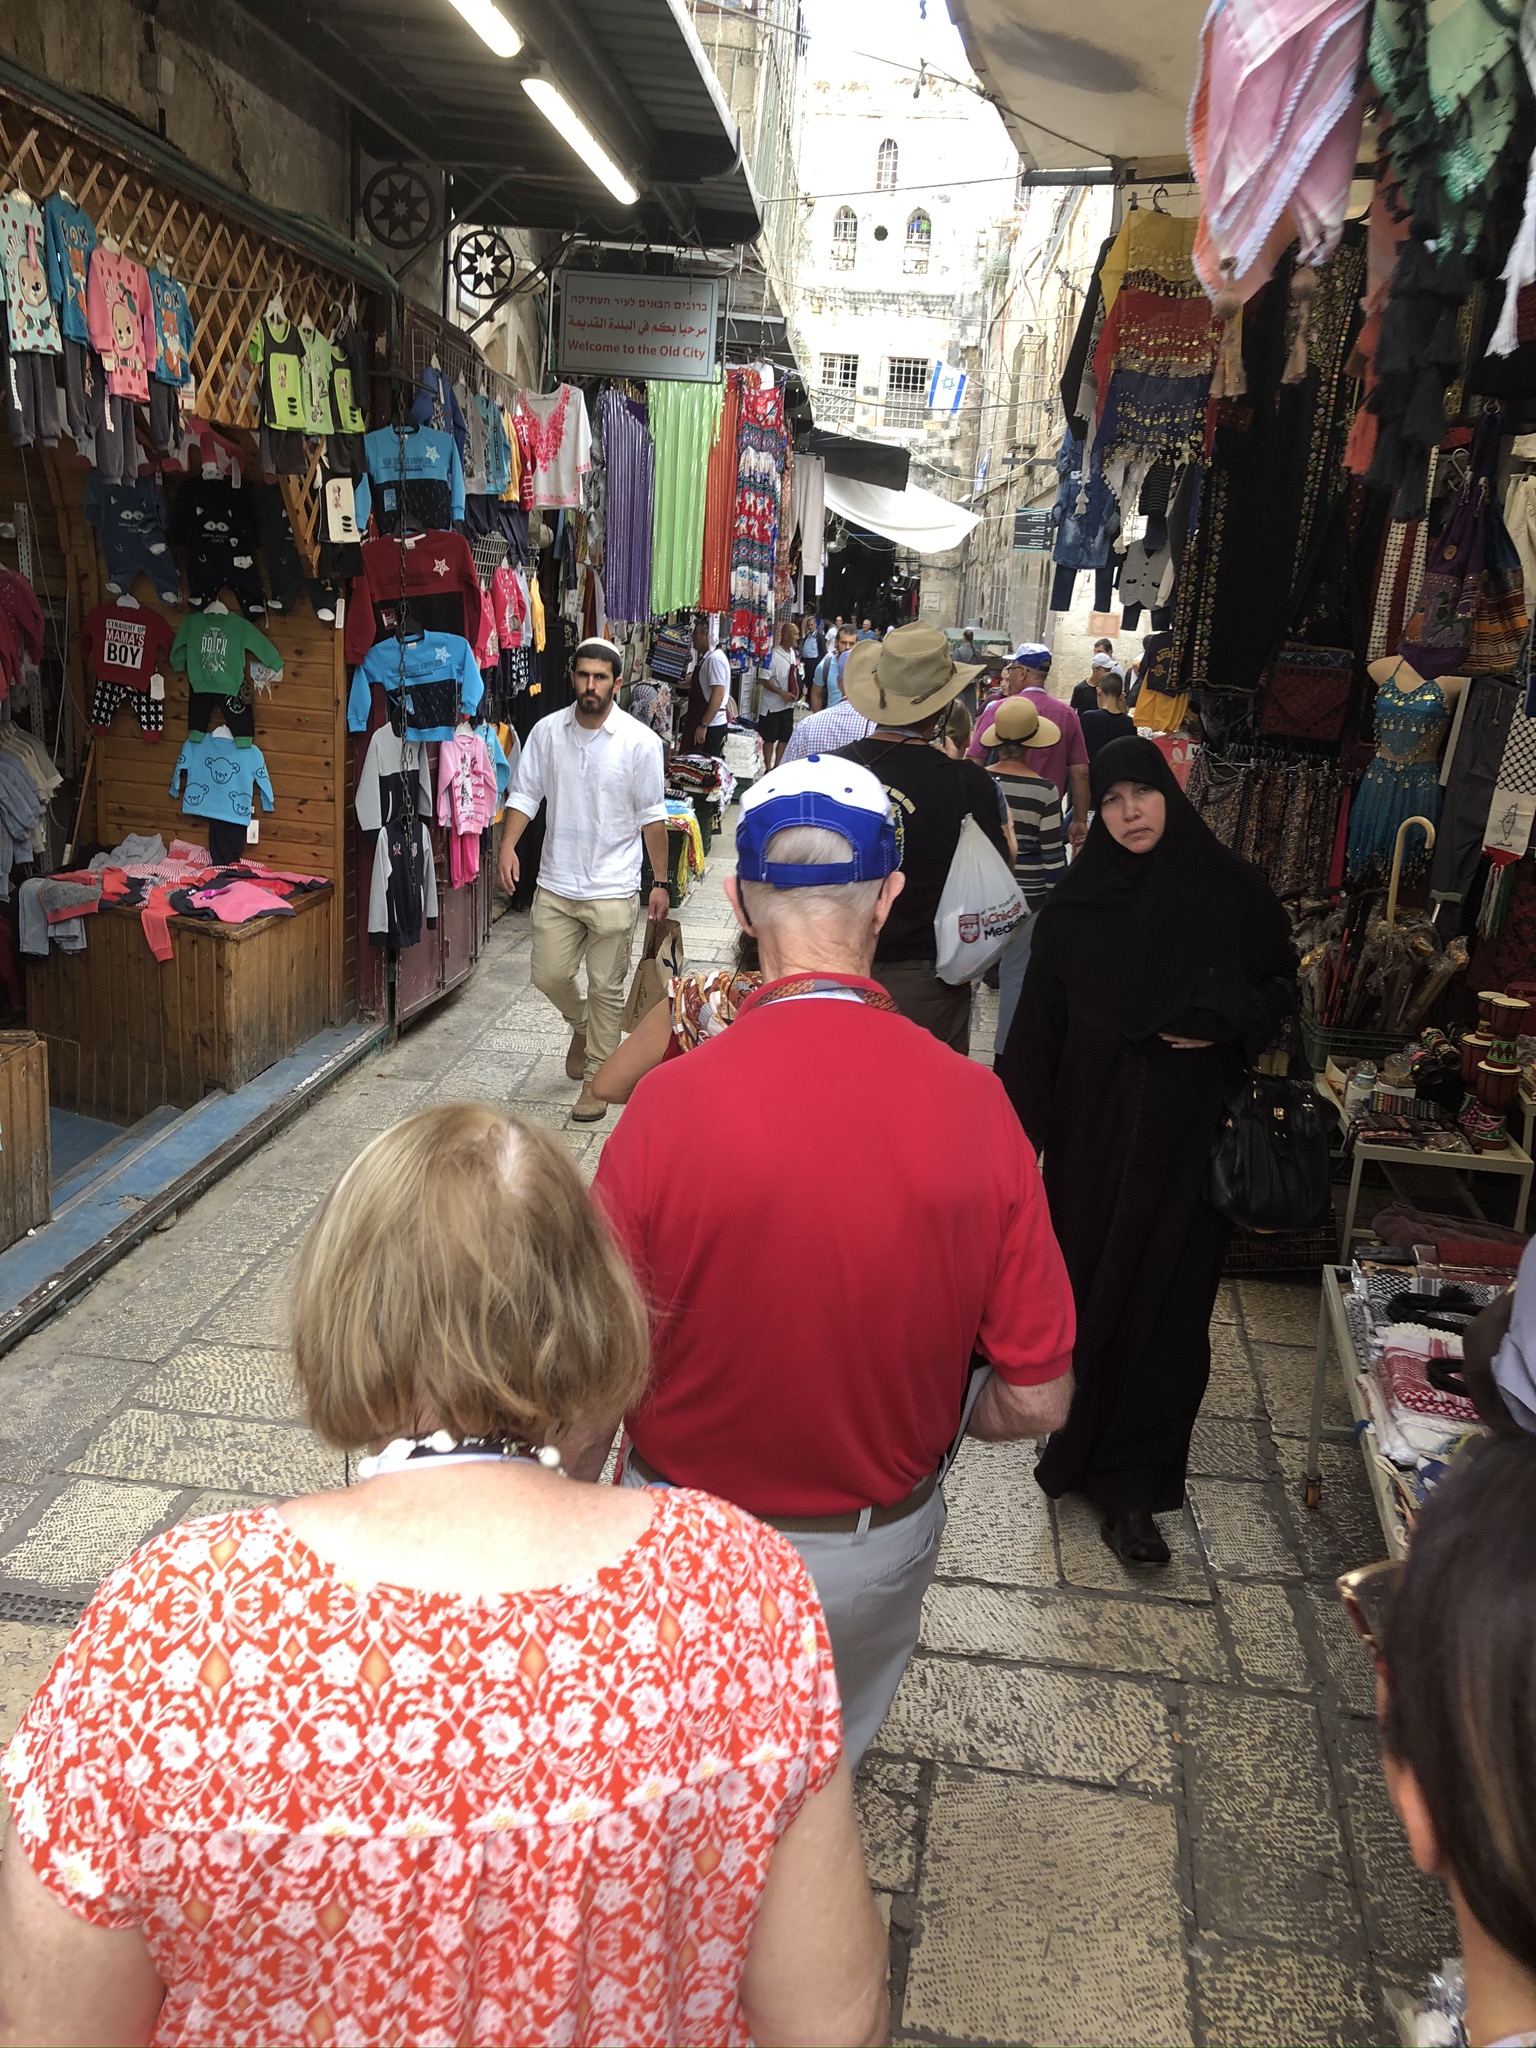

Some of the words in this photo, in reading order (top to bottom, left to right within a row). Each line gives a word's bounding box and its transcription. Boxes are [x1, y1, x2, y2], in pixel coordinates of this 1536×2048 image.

[570, 294, 610, 305] העתיקה
[613, 296, 636, 307] לעיר
[638, 299, 671, 309] הבאים
[673, 301, 708, 311] ברוכים
[567, 314, 607, 331] القديمة
[608, 317, 636, 333] البلدة
[637, 319, 650, 337] في
[651, 320, 677, 337] بكم
[567, 339, 620, 354] Welcome
[623, 343, 635, 354] to
[637, 344, 657, 356] the
[659, 345, 680, 357] Old
[683, 347, 706, 361] City
[107, 620, 136, 632] STRAIGHT
[105, 629, 145, 647] MAMA'S
[200, 636, 228, 657] ROCK
[106, 642, 141, 666] BOY
